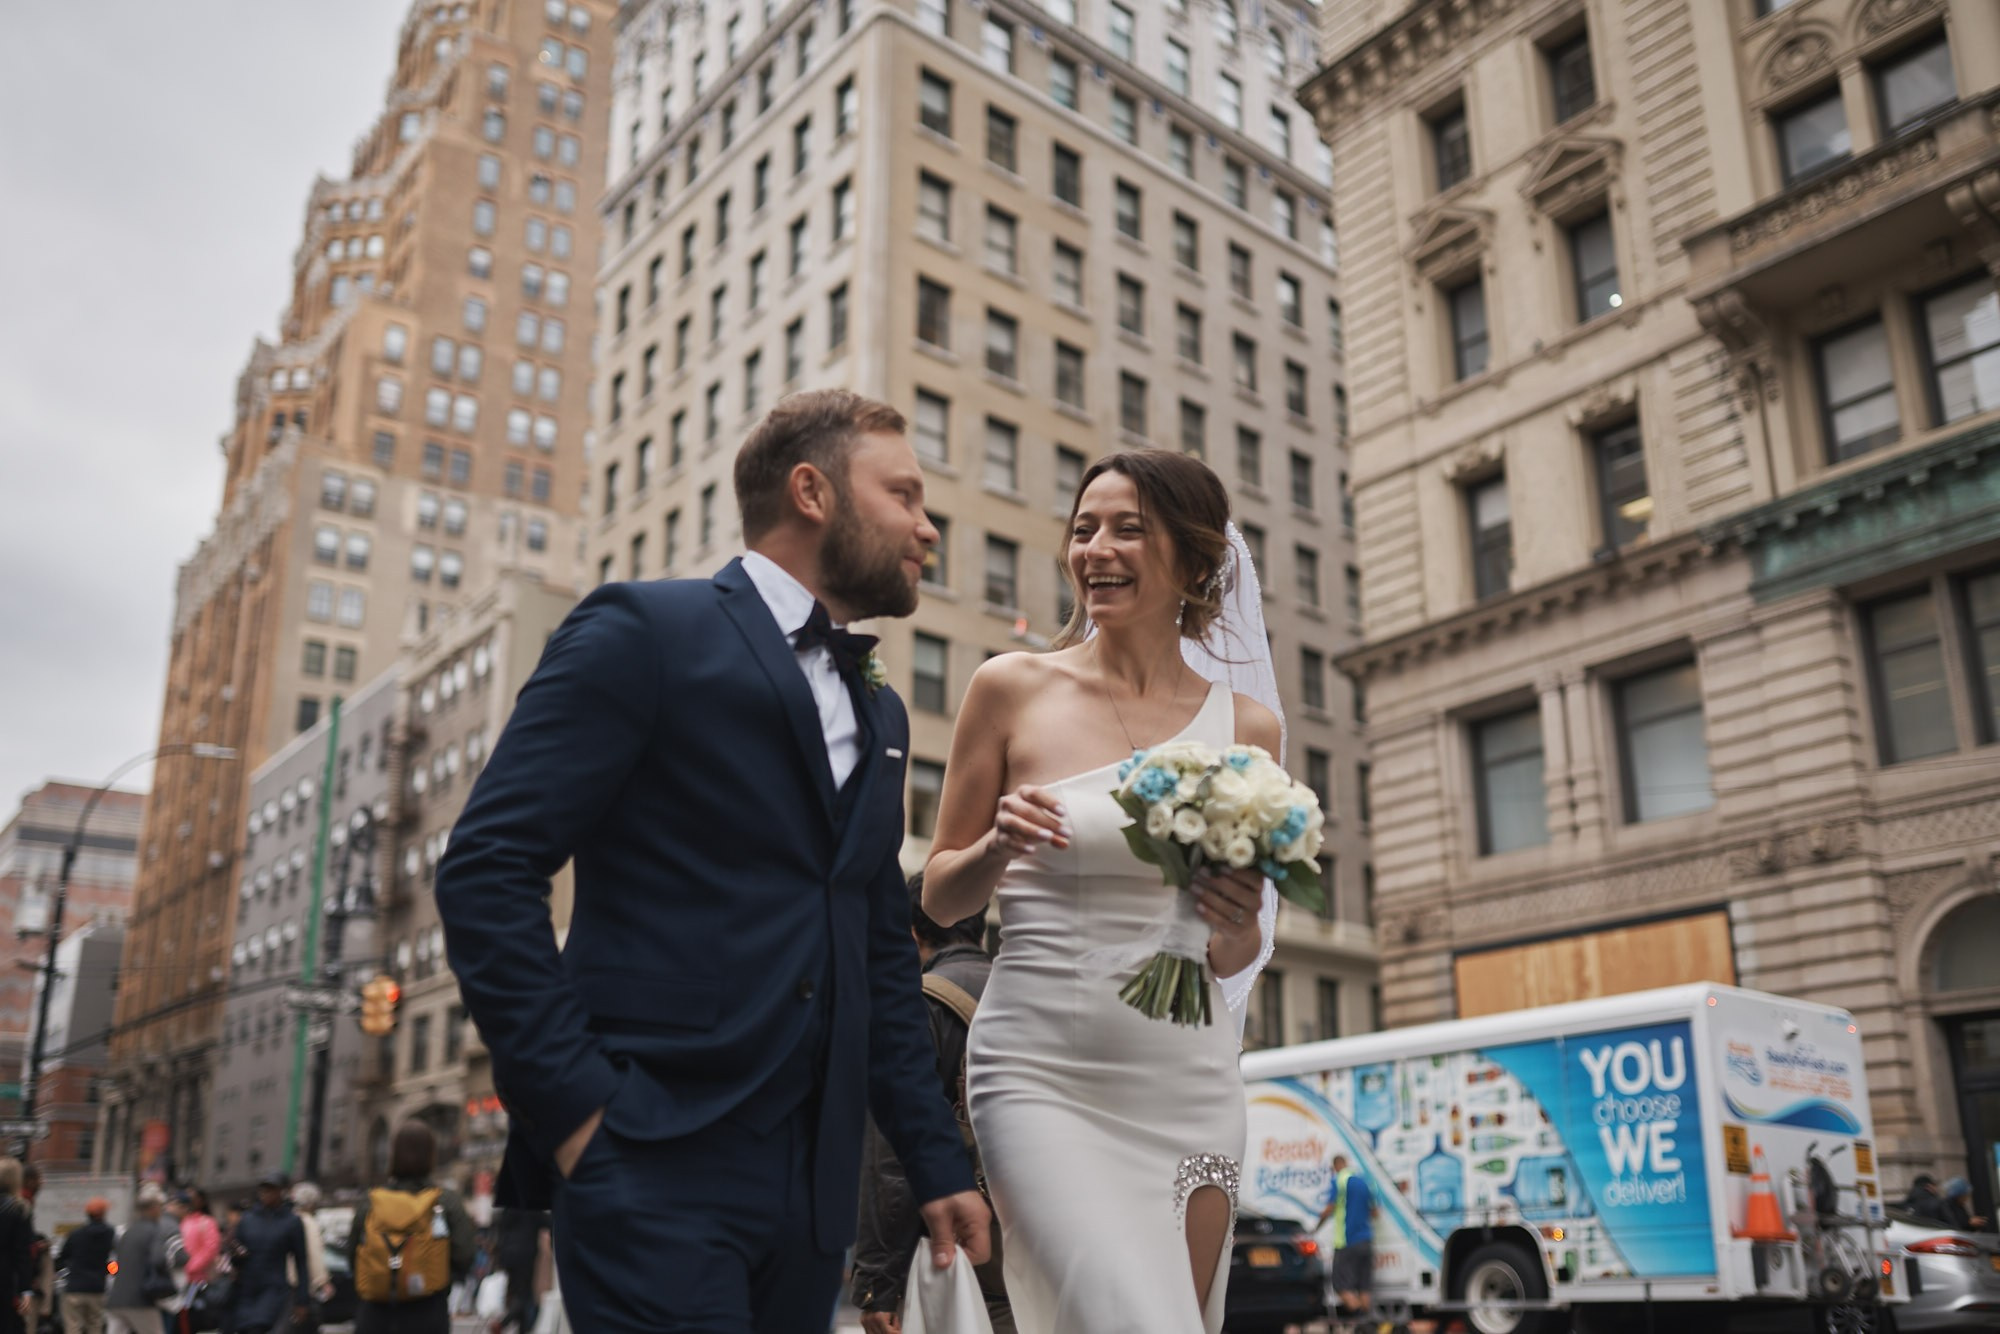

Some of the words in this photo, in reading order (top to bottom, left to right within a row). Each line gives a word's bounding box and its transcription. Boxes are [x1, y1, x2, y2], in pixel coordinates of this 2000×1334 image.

[1579, 1035, 1687, 1098] YOU
[1592, 1092, 1682, 1126] choose
[1262, 1135, 1325, 1166] Ready
[1598, 1119, 1682, 1176] WE
[1603, 1171, 1687, 1207] deliver!
